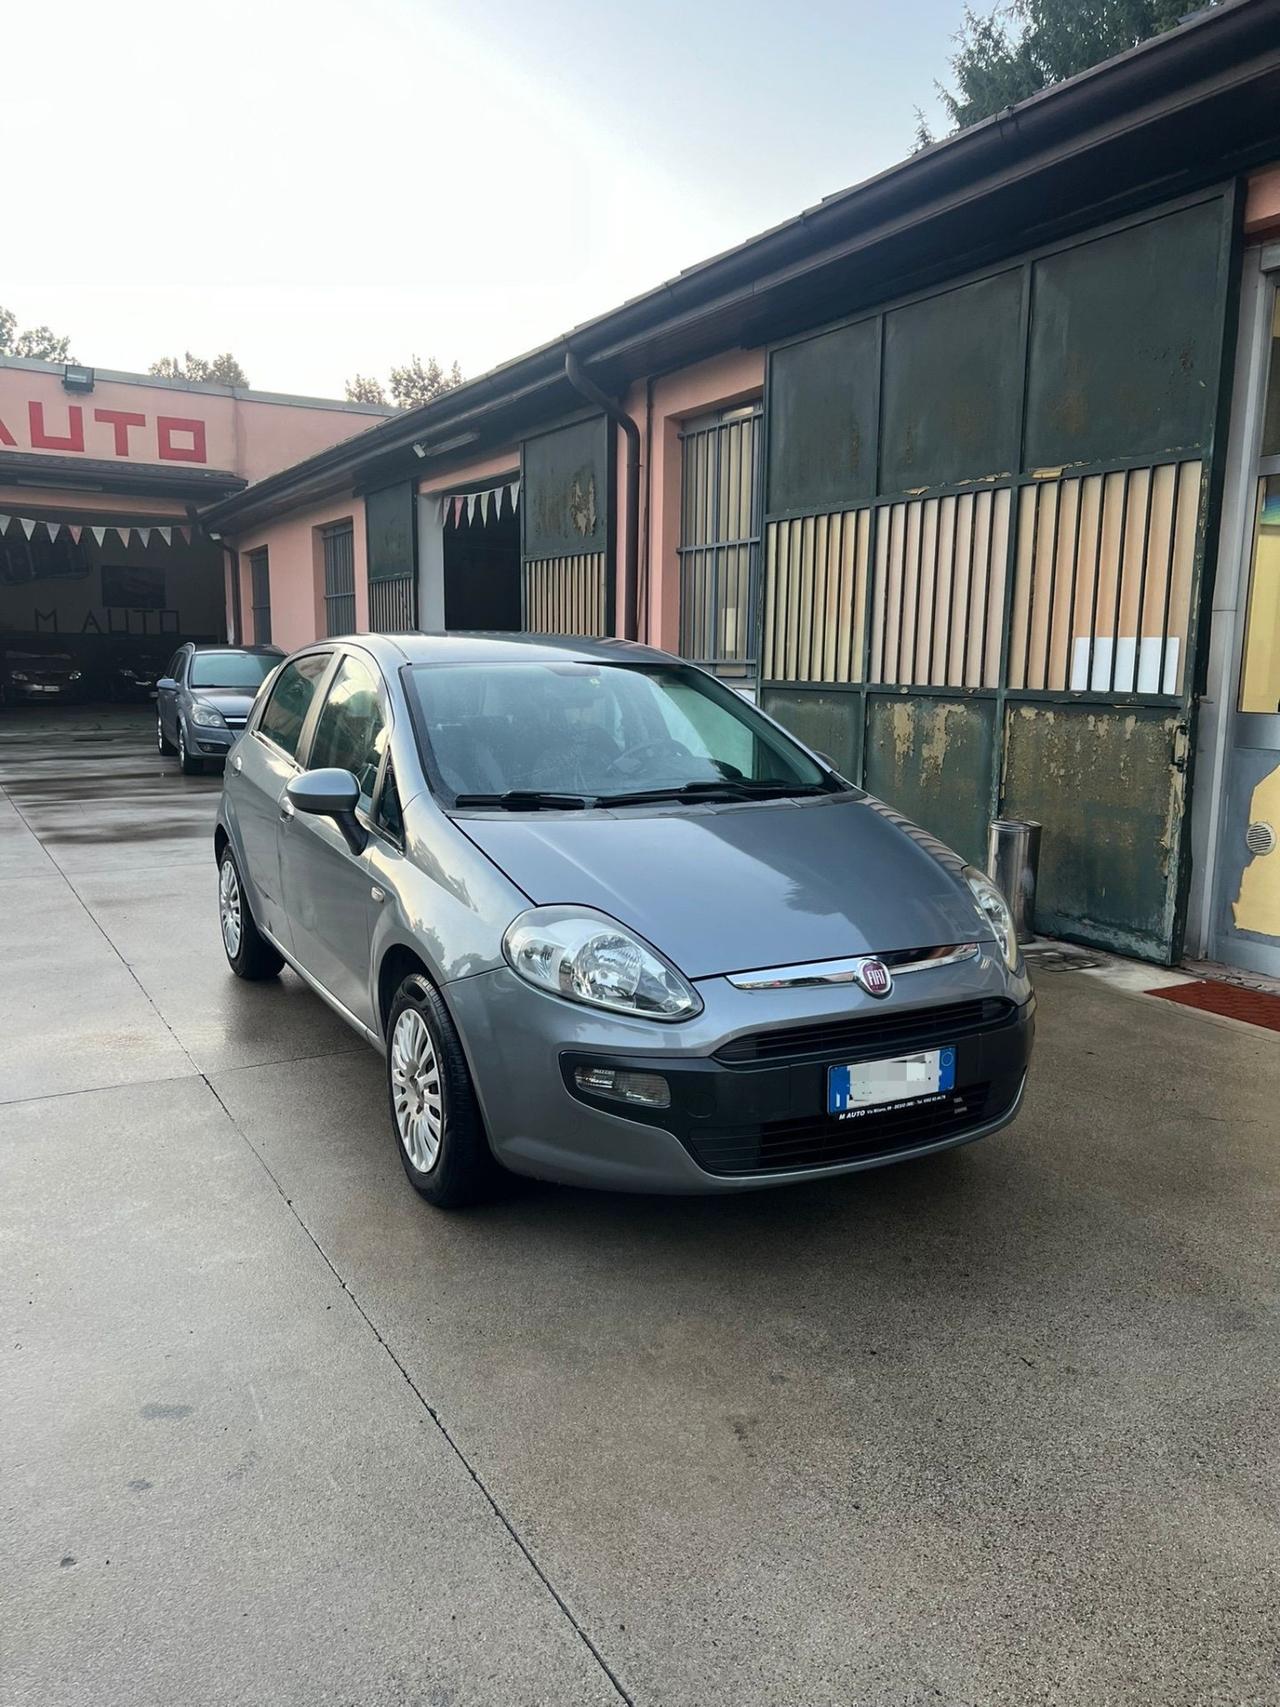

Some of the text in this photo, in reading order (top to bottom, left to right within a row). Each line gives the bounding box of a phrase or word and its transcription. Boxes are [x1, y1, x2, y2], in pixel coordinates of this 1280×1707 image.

[34, 607, 180, 635] M AUTO
[867, 969, 886, 986] FIAT
[846, 1110, 866, 1119] AUTO
